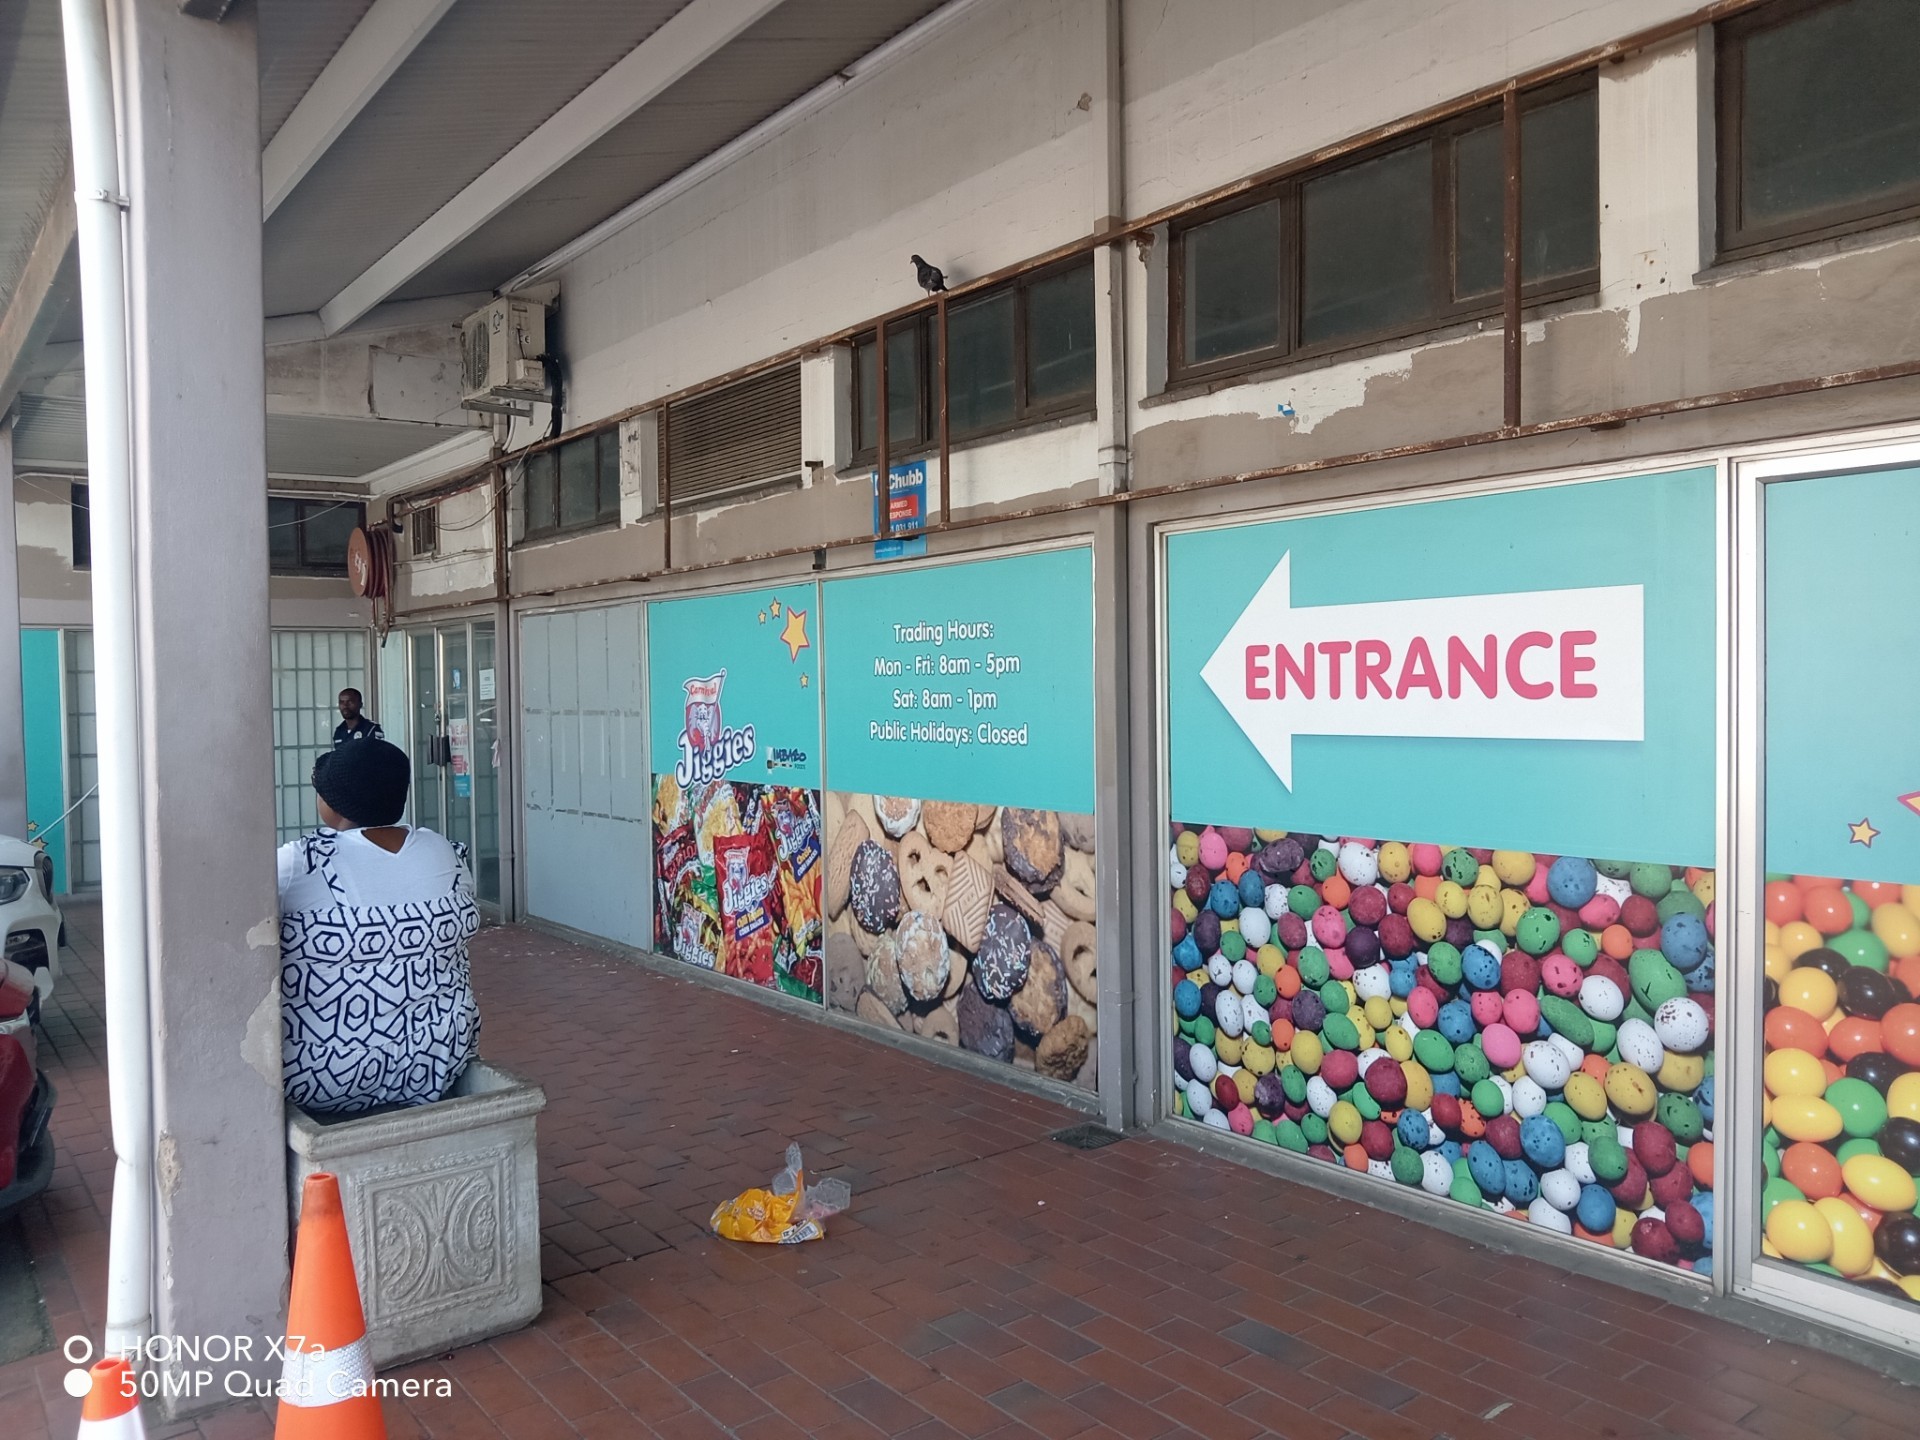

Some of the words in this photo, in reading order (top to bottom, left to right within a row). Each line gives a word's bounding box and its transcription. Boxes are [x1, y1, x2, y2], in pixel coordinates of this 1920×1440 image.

[888, 468, 924, 490] Chubb
[889, 509, 913, 520] ESPONSE
[893, 621, 943, 646] Trading
[947, 619, 994, 640] Hours:
[874, 657, 902, 676] Mon
[915, 654, 935, 675] Fri:
[939, 655, 970, 674] 8am
[985, 652, 1020, 679] 5pm
[1245, 630, 1598, 700] ENTRANCE
[893, 689, 918, 709] Sat:
[922, 689, 952, 709] 8am
[967, 688, 997, 714] 1pm
[870, 721, 907, 741] Public
[910, 721, 973, 748] Holidays:
[977, 722, 1028, 746] Closed
[676, 724, 755, 789] Jiggies
[776, 811, 814, 861] Jiggies
[723, 873, 768, 916] Jiggies
[673, 924, 715, 967] Jiggies
